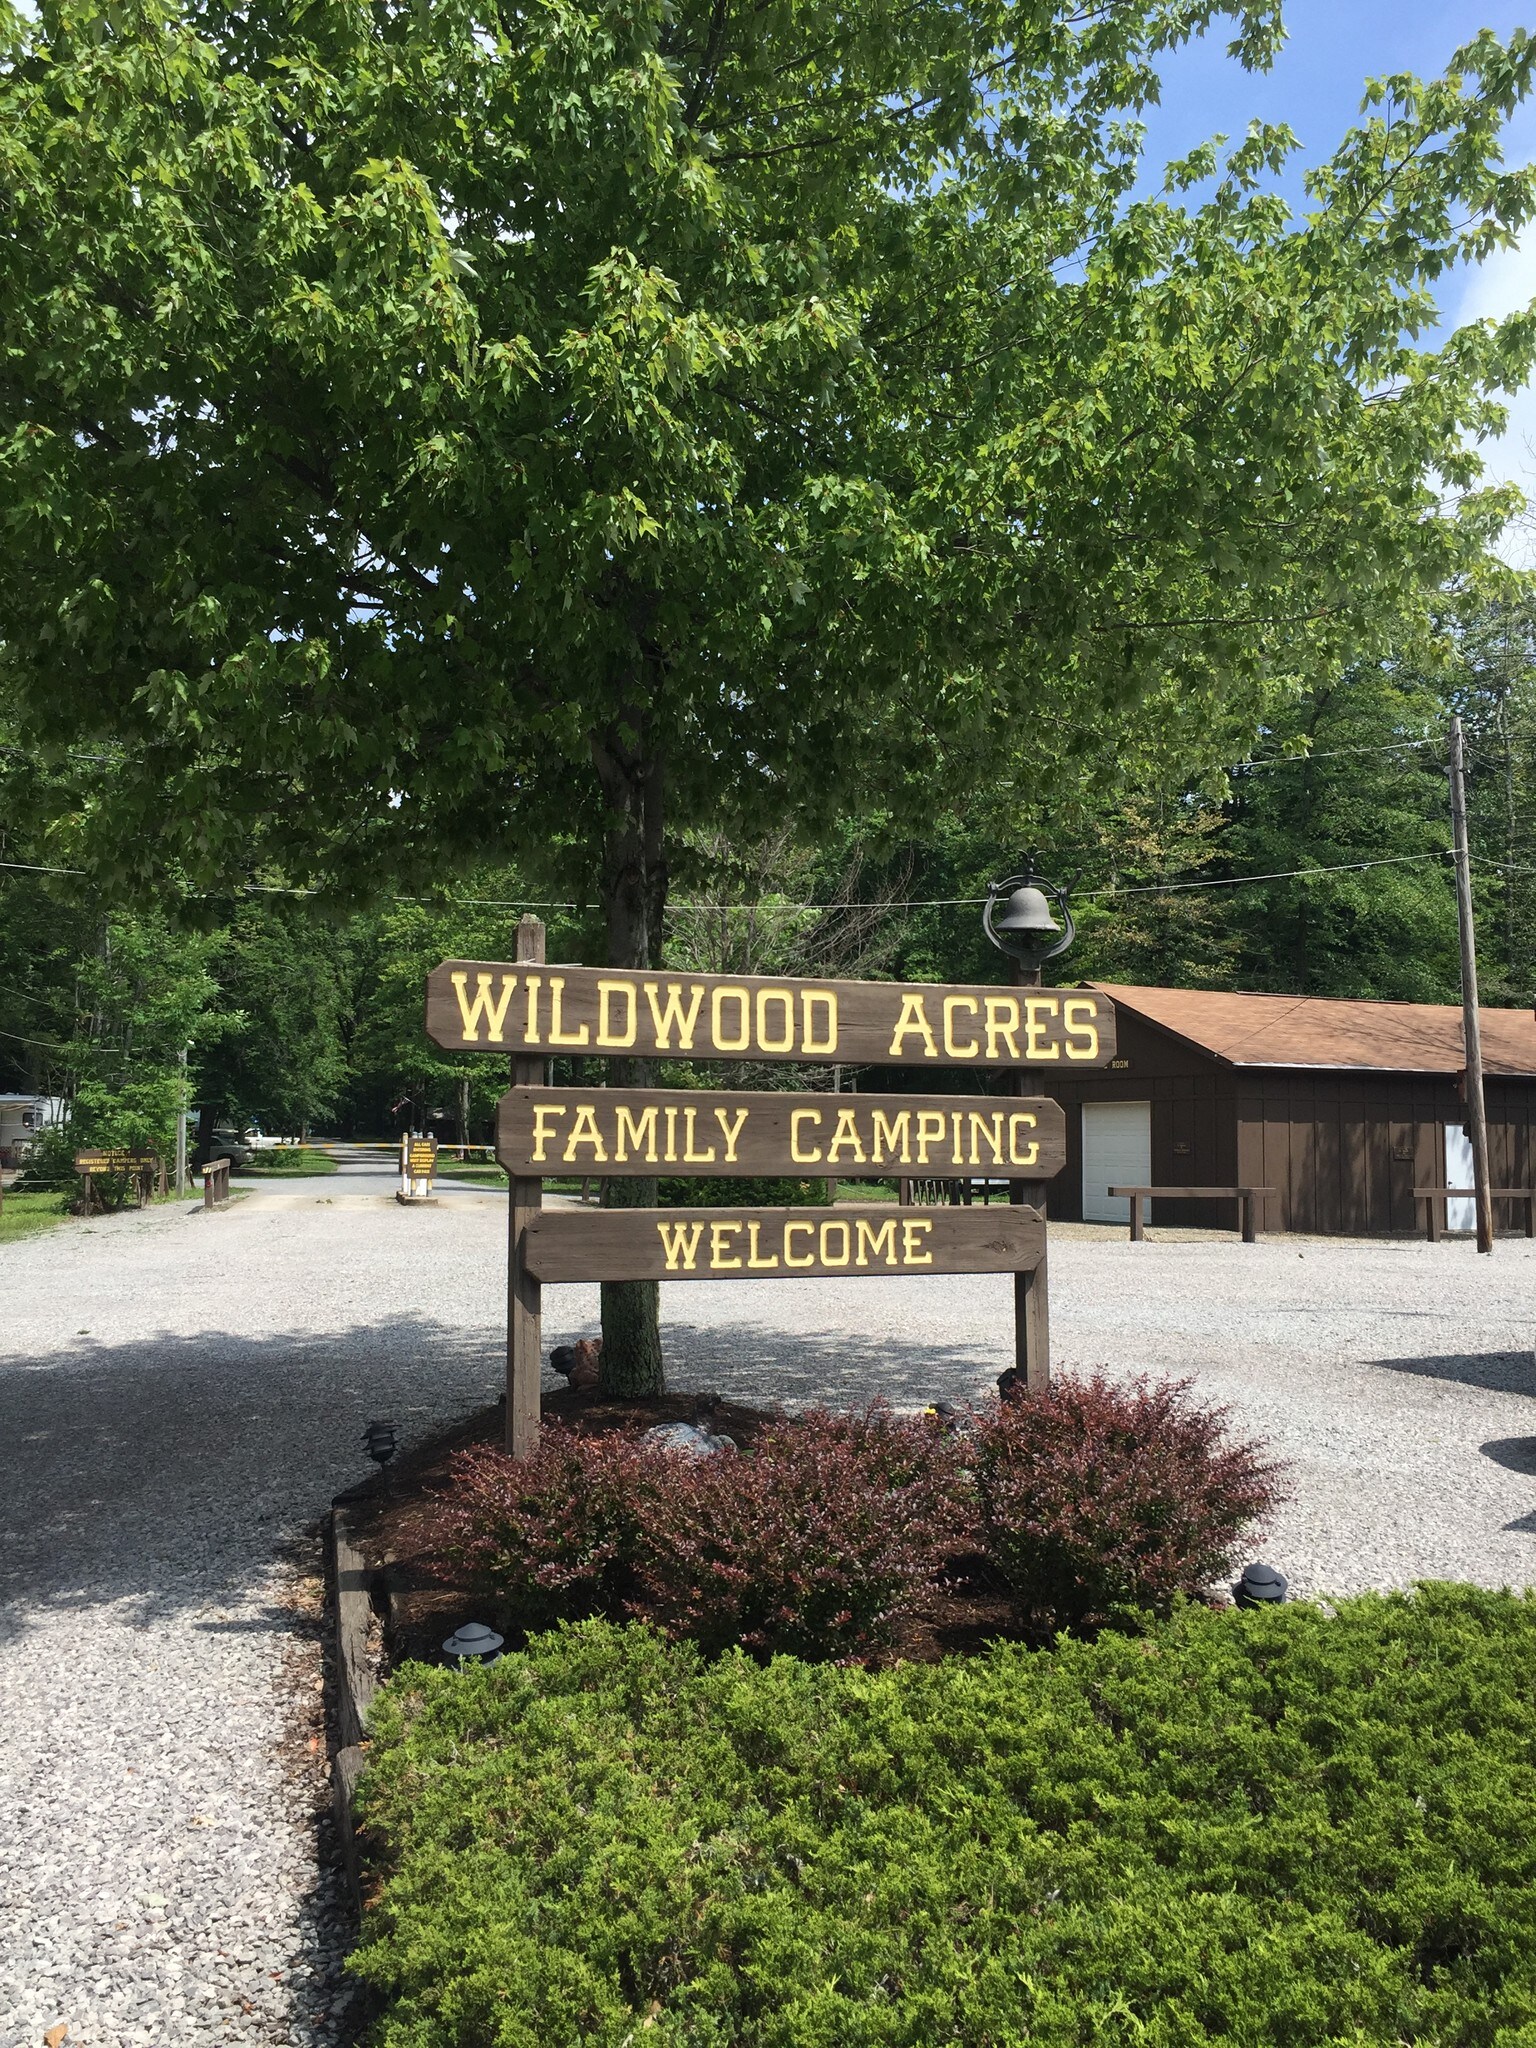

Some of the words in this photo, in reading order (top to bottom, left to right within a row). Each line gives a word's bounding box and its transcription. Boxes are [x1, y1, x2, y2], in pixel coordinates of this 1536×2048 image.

[449, 971, 838, 1053] WILDWOOD
[887, 993, 1099, 1060] ACRES
[1112, 1060, 1129, 1069] ROOM
[531, 1104, 750, 1163] FAMILY
[790, 1108, 1041, 1165] CAMPING
[656, 1219, 933, 1271] WELCOME
